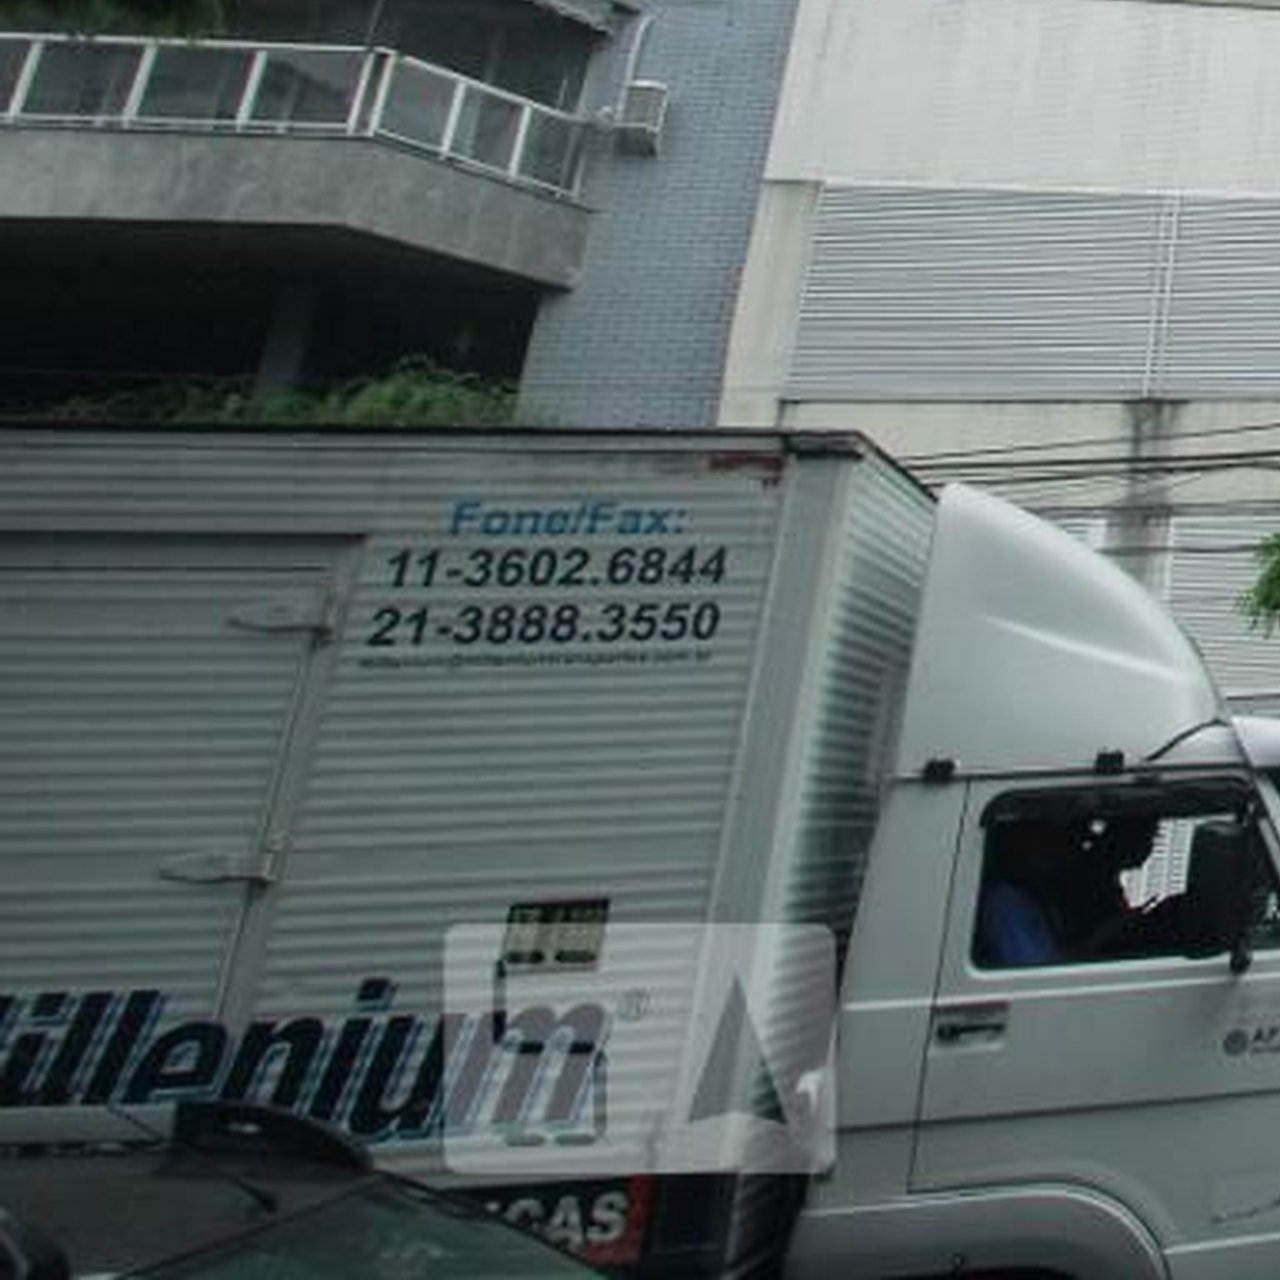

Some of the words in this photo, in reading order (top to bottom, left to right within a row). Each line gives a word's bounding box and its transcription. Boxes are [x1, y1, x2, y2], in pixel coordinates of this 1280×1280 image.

[449, 497, 690, 535] Fone/Fax:
[387, 545, 727, 588] 11-3602.6844
[366, 601, 721, 647] 21-3888.3550
[0, 977, 612, 1145] illenium
